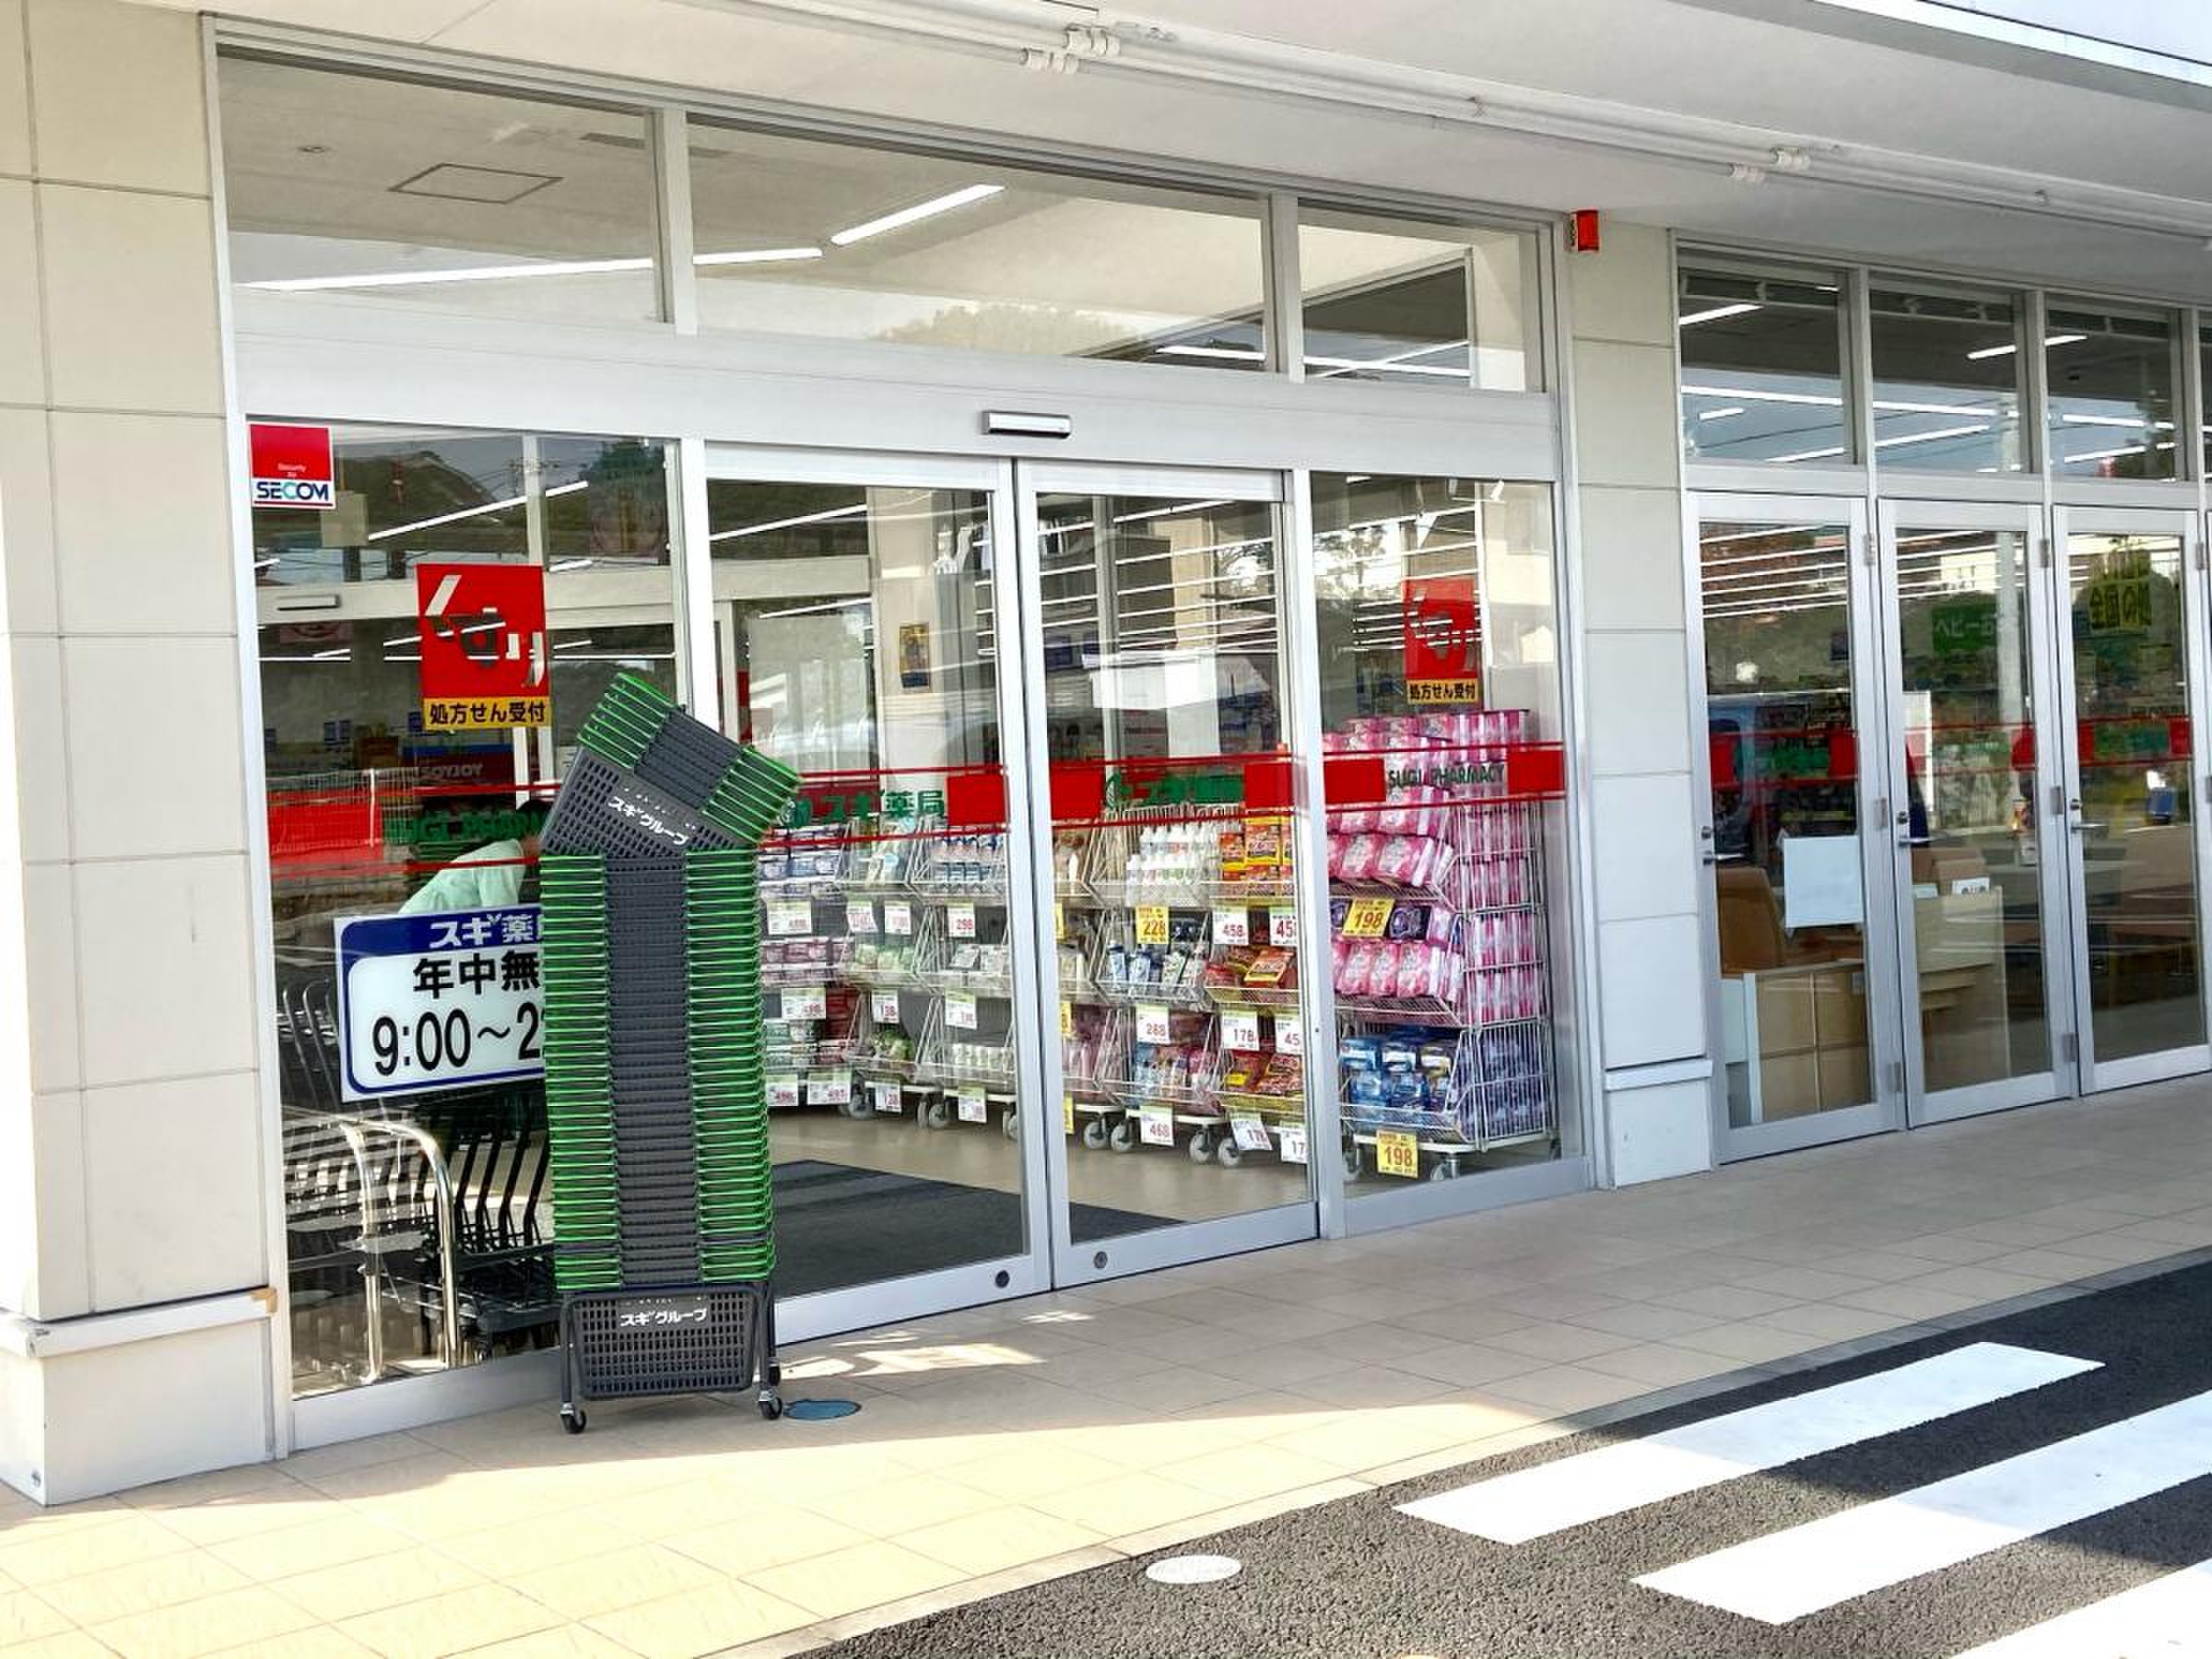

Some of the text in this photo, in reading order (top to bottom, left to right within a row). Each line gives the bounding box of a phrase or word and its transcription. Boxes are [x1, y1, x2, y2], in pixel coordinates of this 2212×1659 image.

[256, 481, 329, 501] SECOM
[1409, 683, 1476, 700] 処方せん受付
[429, 701, 546, 724] 処方せん受付
[420, 764, 483, 778] SOYJOY
[1385, 764, 1505, 788] SUGI PHARMACY
[607, 795, 689, 845] スギグループ
[1143, 921, 1167, 936] 228
[1276, 920, 1297, 938] 45
[1355, 912, 1383, 929] 198
[413, 950, 541, 999] 年中無
[372, 1001, 546, 1077] 9:00～2
[1233, 1028, 1254, 1042] 178
[1284, 1033, 1300, 1047] 45
[1291, 1139, 1305, 1156] 17
[1385, 1146, 1413, 1167] 198
[619, 1307, 708, 1328] スギグループ
